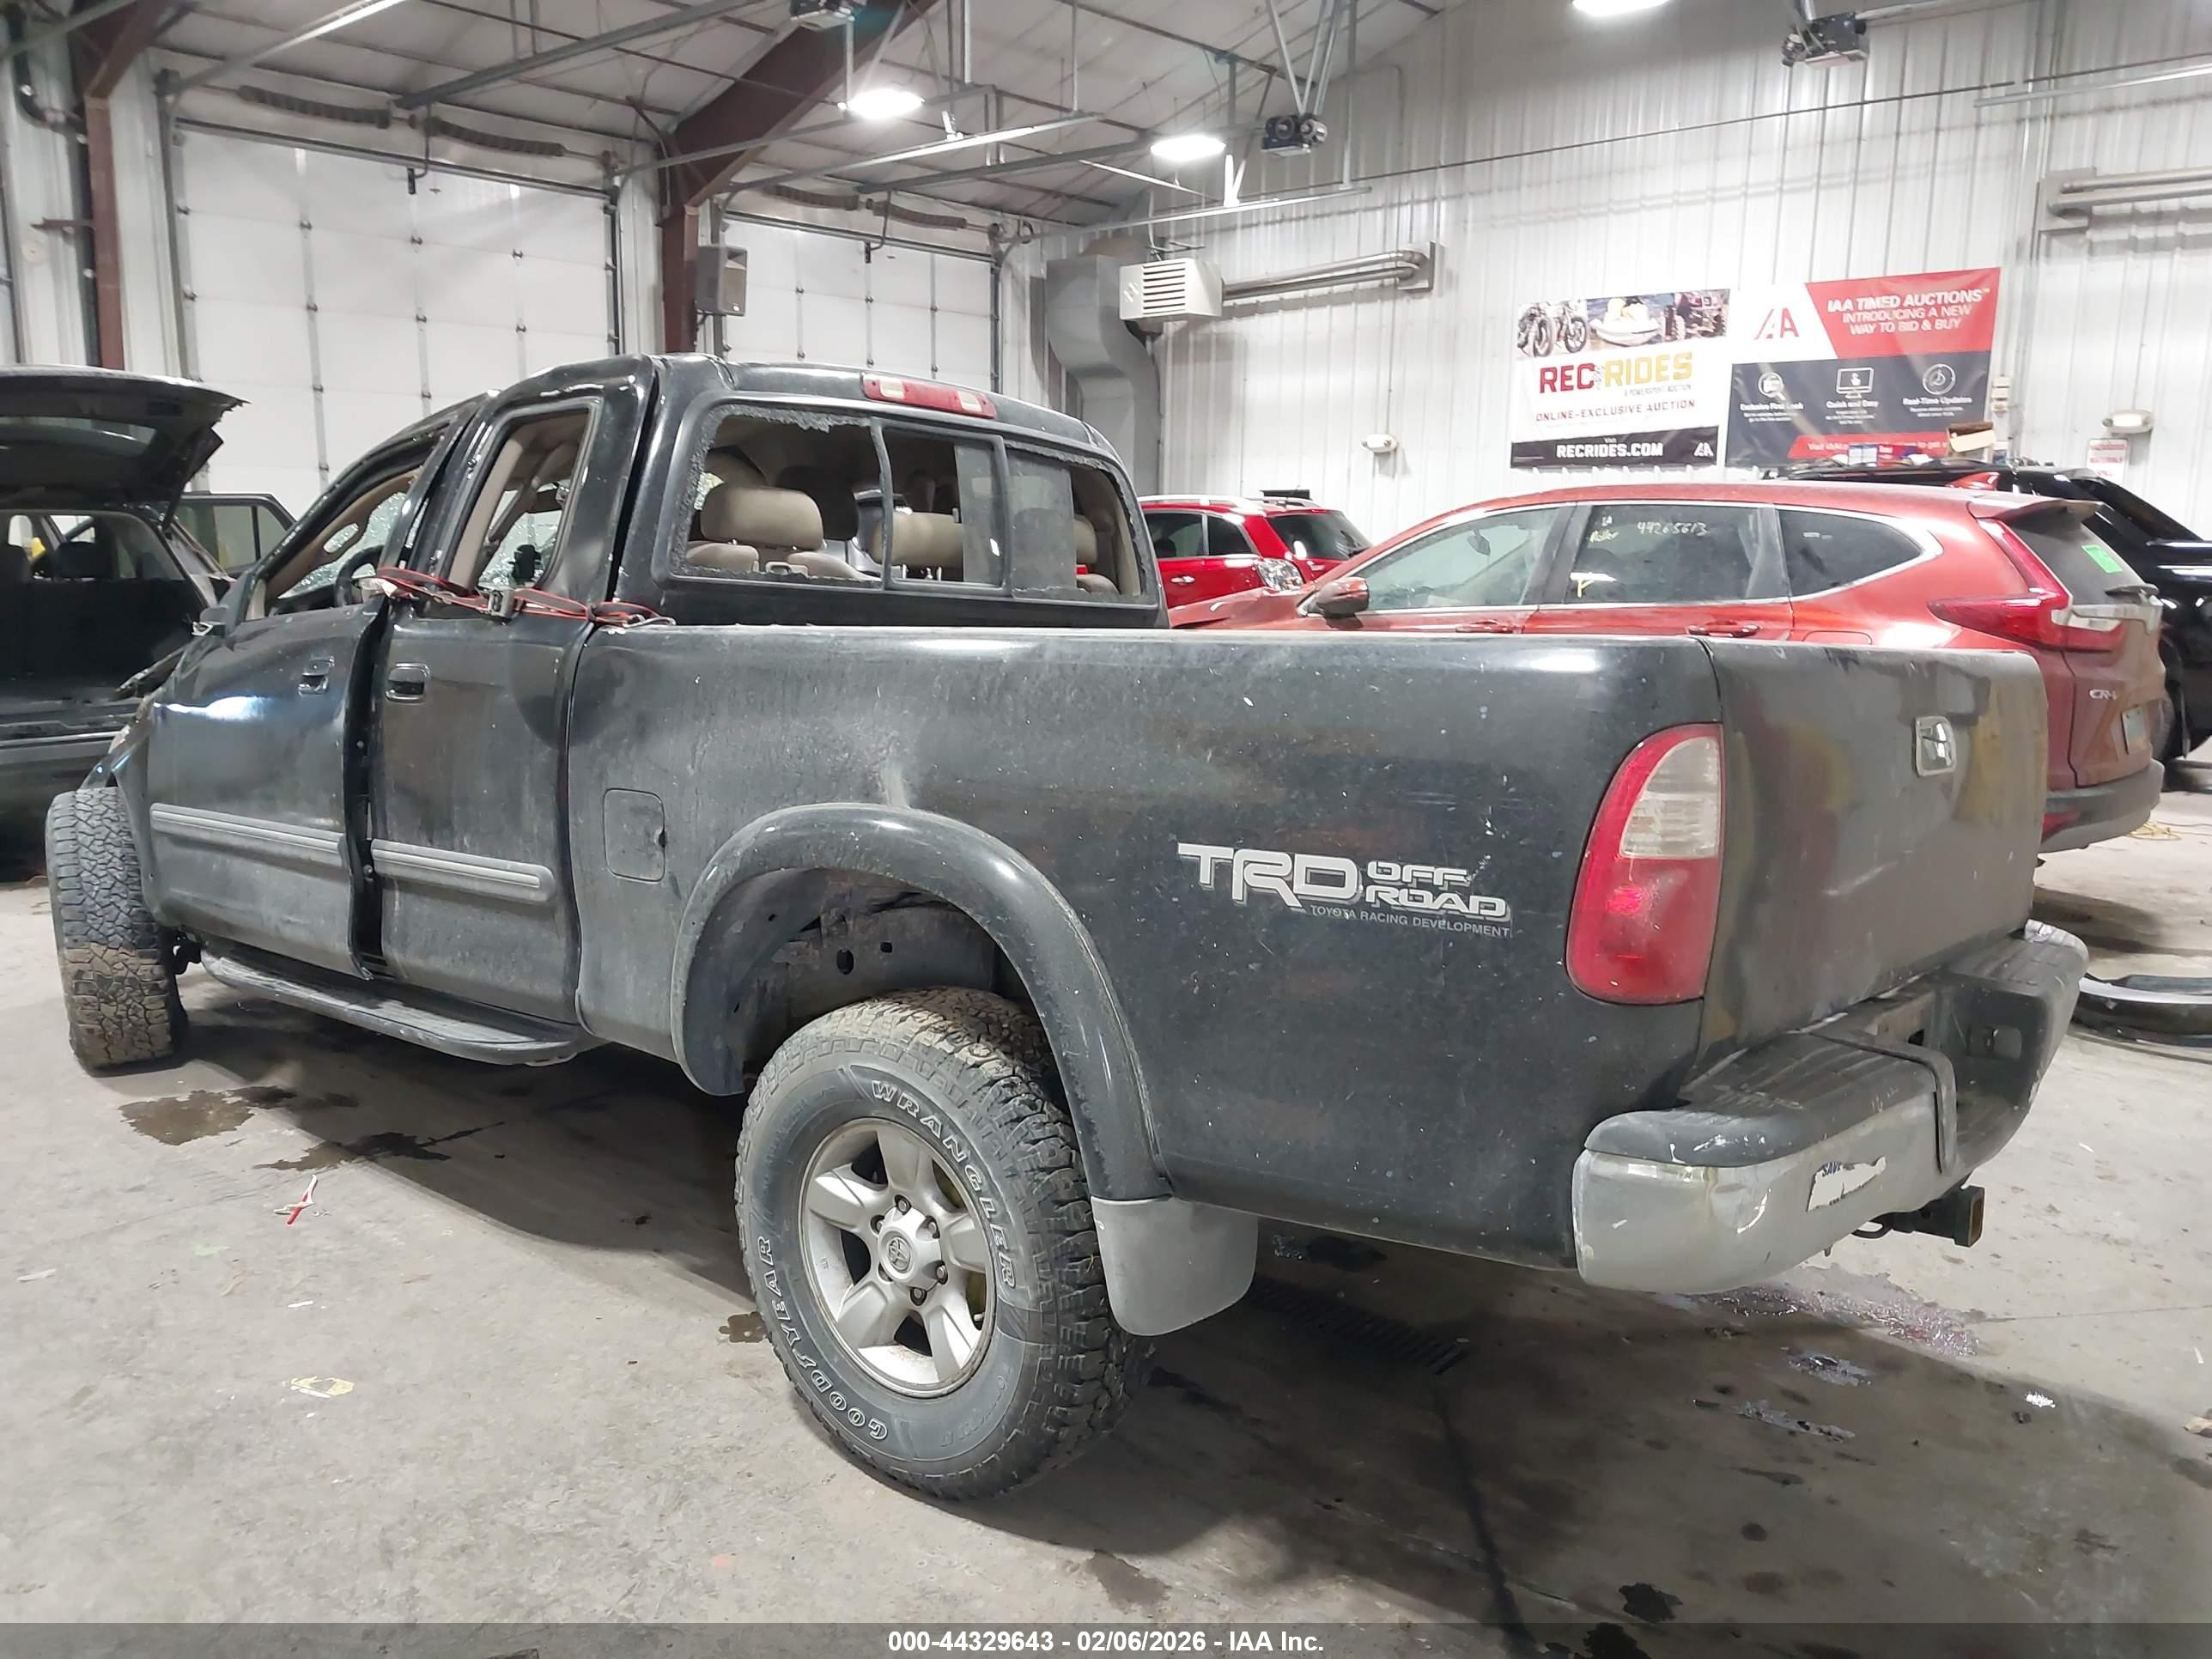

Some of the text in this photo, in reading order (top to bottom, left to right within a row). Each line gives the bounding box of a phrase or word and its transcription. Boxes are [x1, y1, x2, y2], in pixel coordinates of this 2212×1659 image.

[1827, 300, 1854, 313] IAA
[1856, 295, 1900, 311] TIMED
[1928, 307, 1938, 318] A
[1941, 305, 1973, 318] NEW
[1850, 318, 1962, 336] WAY TO BID & BUY
[1535, 399, 1696, 422] ONLINE-EXCLUSIVE AUCTION
[1556, 442, 1663, 458] RECRIDES.COM
[1177, 842, 1361, 910] TRD
[1367, 860, 1471, 888] OFF
[1365, 884, 1511, 922] ROAD
[1310, 904, 1510, 938] TOYOTA RACING DEVELOPMENT
[871, 1079, 1017, 1289] WRANGLER
[758, 1236, 888, 1441] GOODYEAR
